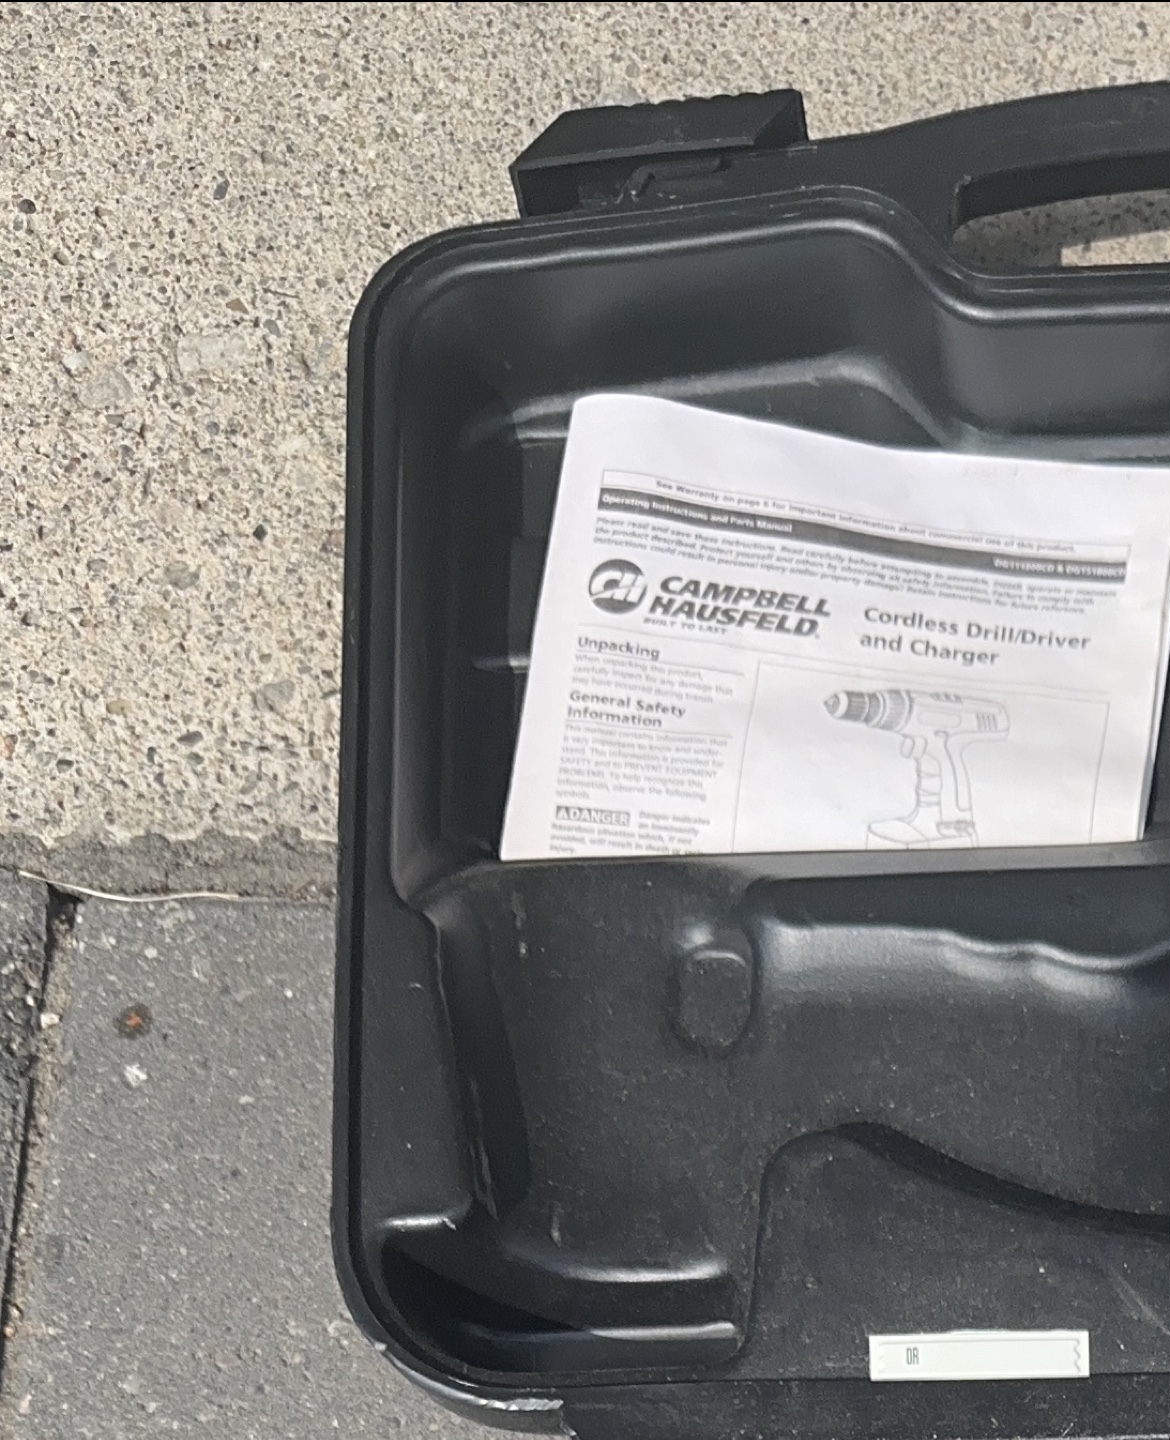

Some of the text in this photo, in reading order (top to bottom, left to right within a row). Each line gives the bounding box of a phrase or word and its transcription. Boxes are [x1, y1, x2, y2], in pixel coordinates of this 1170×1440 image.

[659, 575, 831, 618] CAMPBELL
[649, 596, 819, 638] HAUSFELD
[864, 608, 1091, 651] Cordless Drill/Driver
[578, 636, 660, 661] Unpacking
[860, 633, 1000, 666] and Charger
[567, 706, 662, 727] Information
[570, 690, 686, 718] General Safety
[568, 808, 630, 826] DANGER
